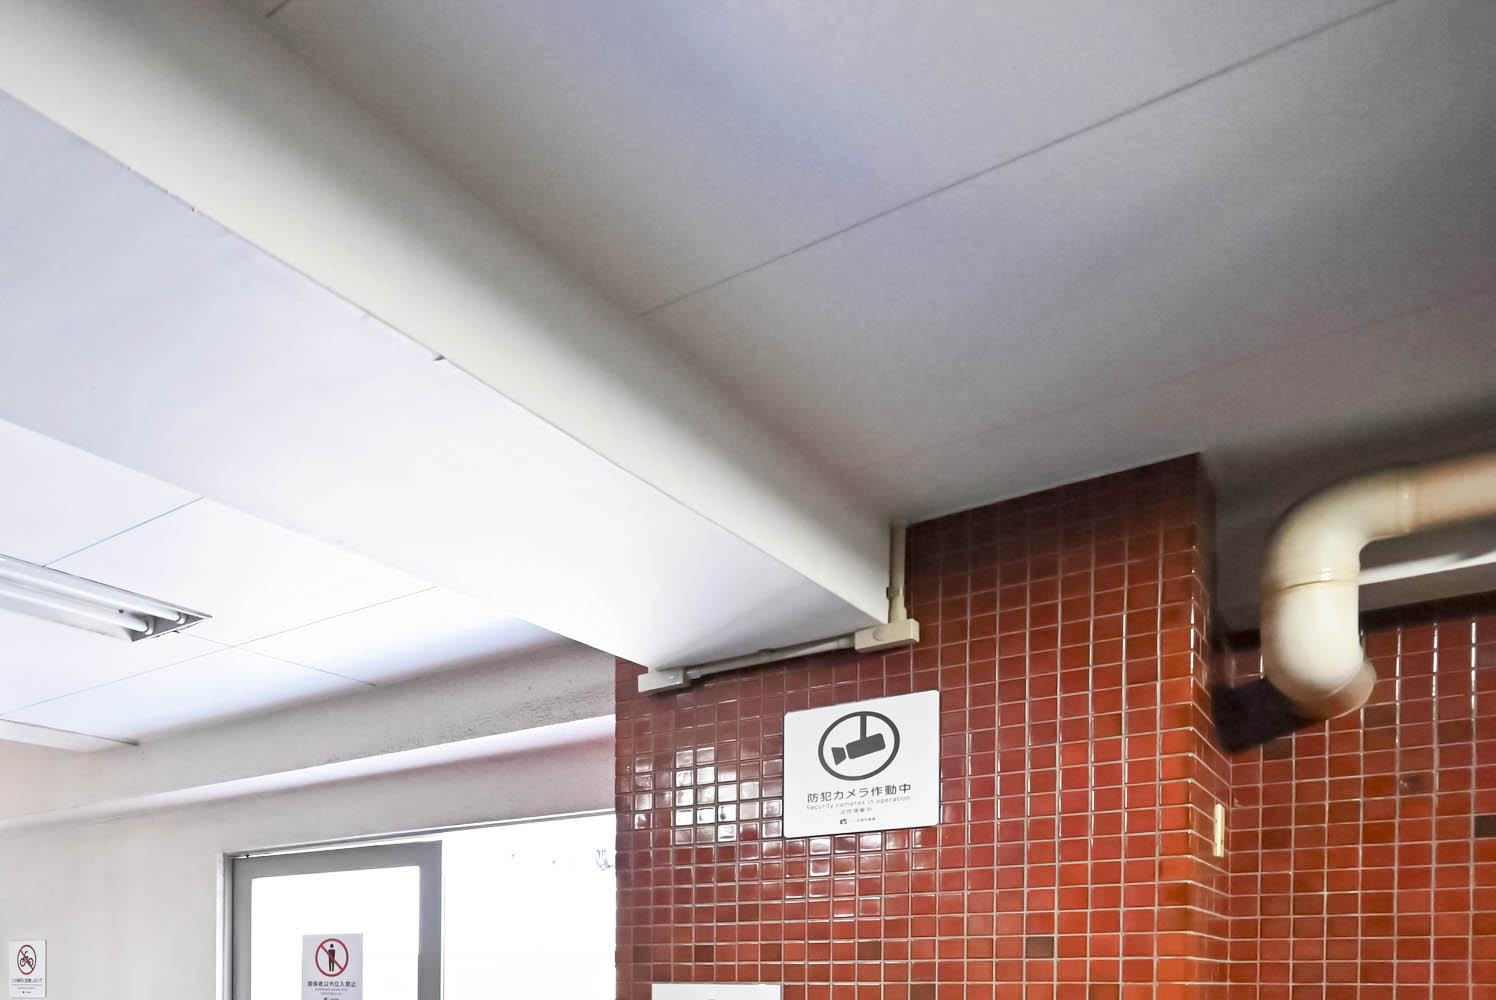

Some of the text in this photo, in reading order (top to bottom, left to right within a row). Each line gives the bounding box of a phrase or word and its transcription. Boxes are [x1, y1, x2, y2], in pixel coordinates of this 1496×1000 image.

[807, 783, 911, 804] 防犯カメラ作動中
